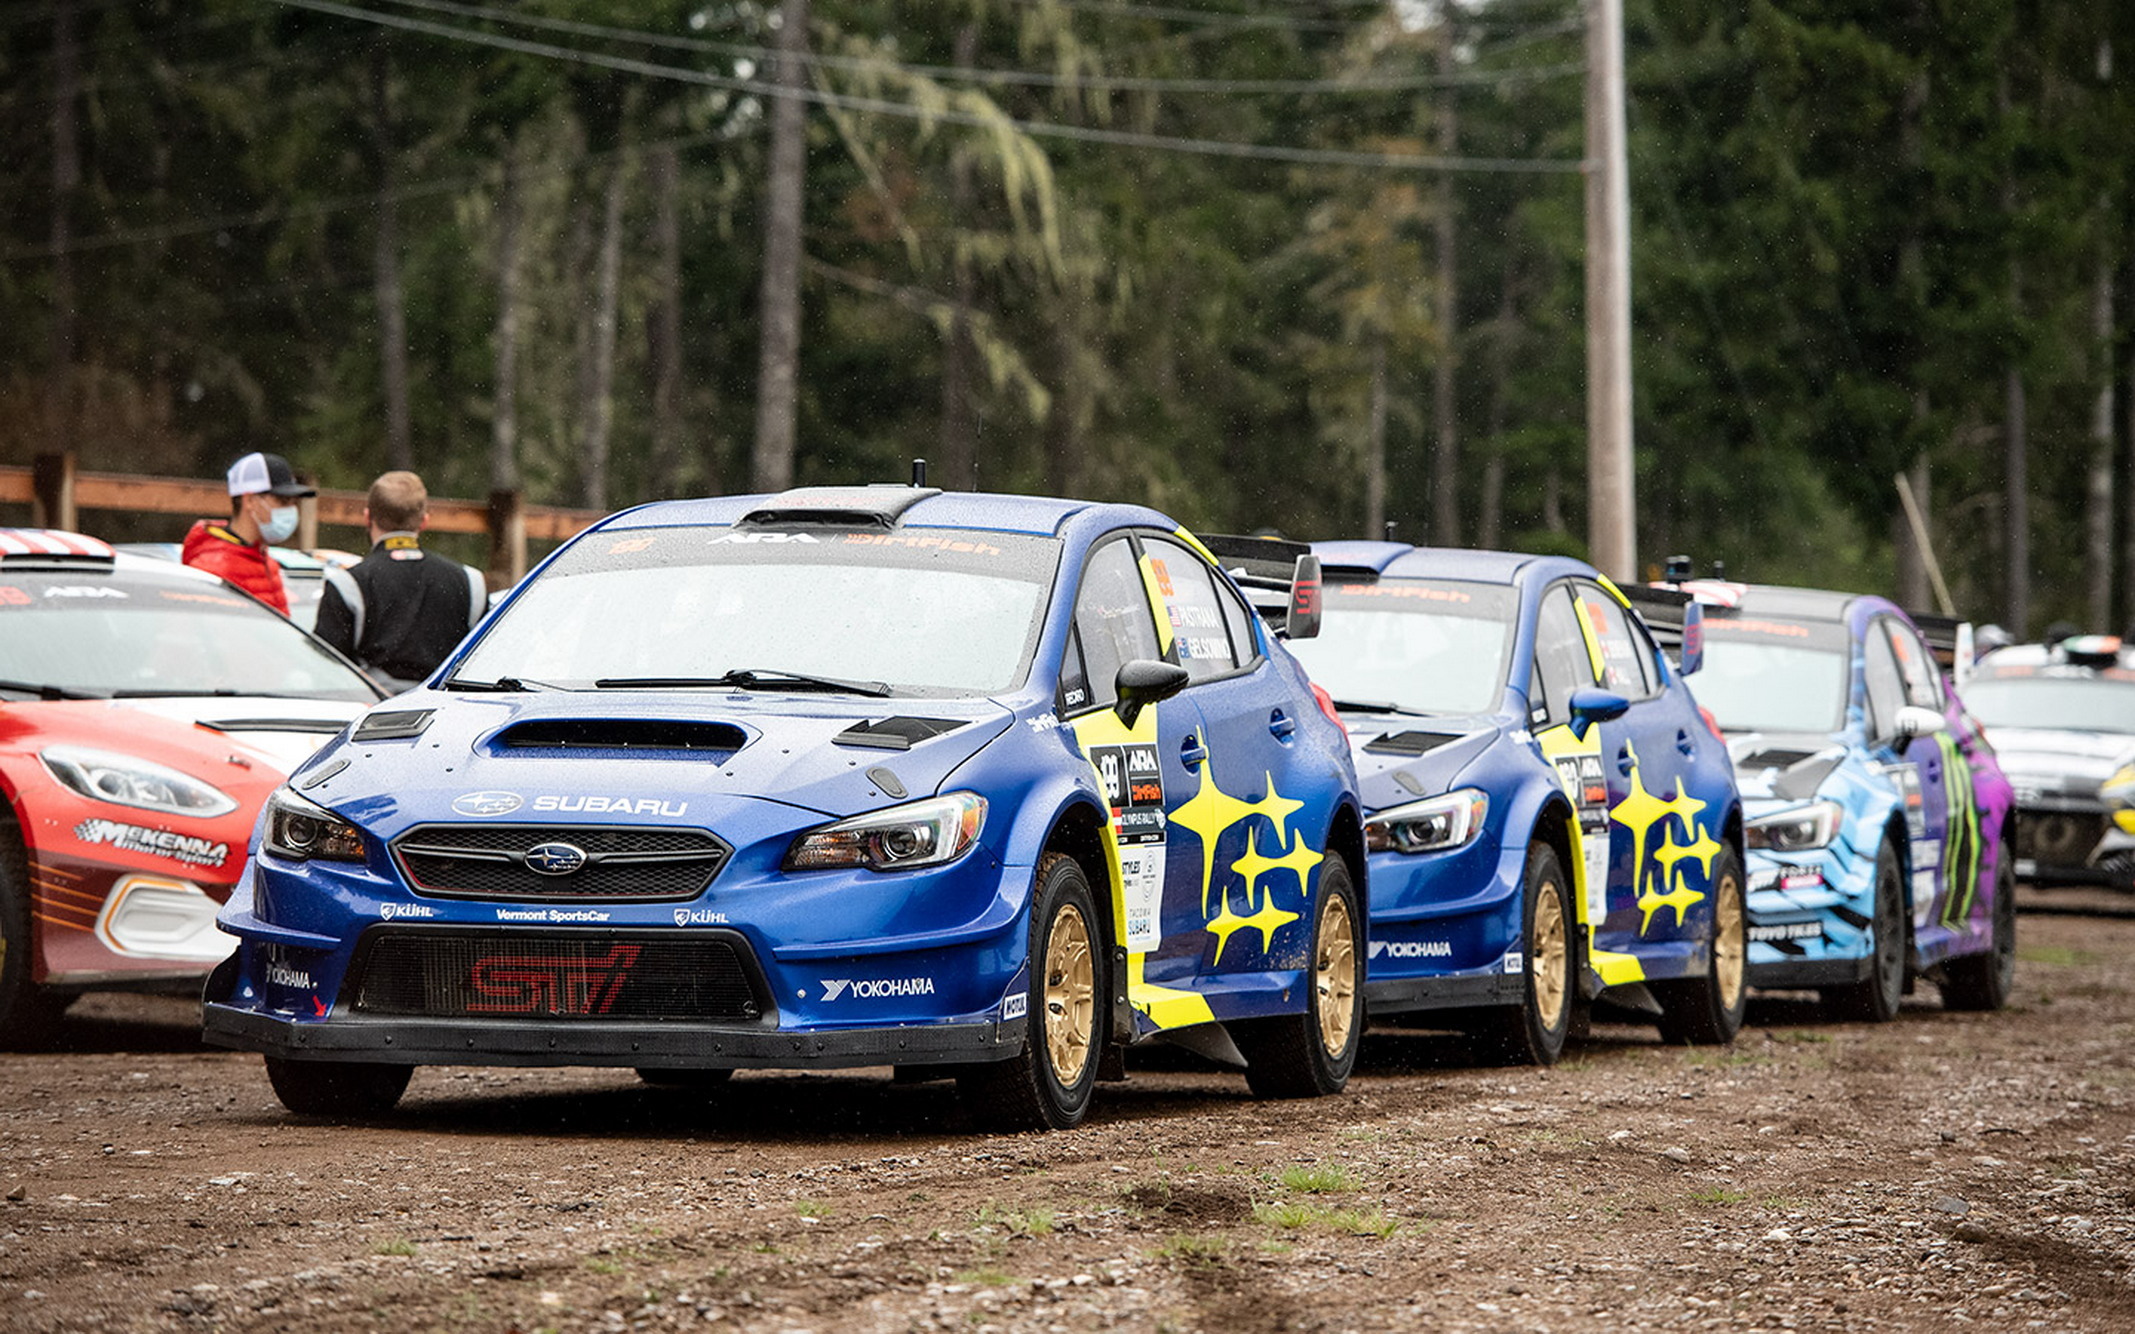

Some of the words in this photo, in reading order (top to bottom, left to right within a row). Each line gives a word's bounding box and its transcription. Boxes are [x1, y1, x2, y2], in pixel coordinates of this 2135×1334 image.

[1129, 749, 1158, 772] ARA
[532, 795, 689, 818] SUBARU
[396, 903, 434, 918] KÜHL
[496, 908, 547, 922] Vermont
[549, 909, 611, 923] SportsCar
[690, 909, 729, 924] KÜHL
[1386, 941, 1452, 958] YOKOHAMA
[850, 976, 935, 999] YOKOHAMA
